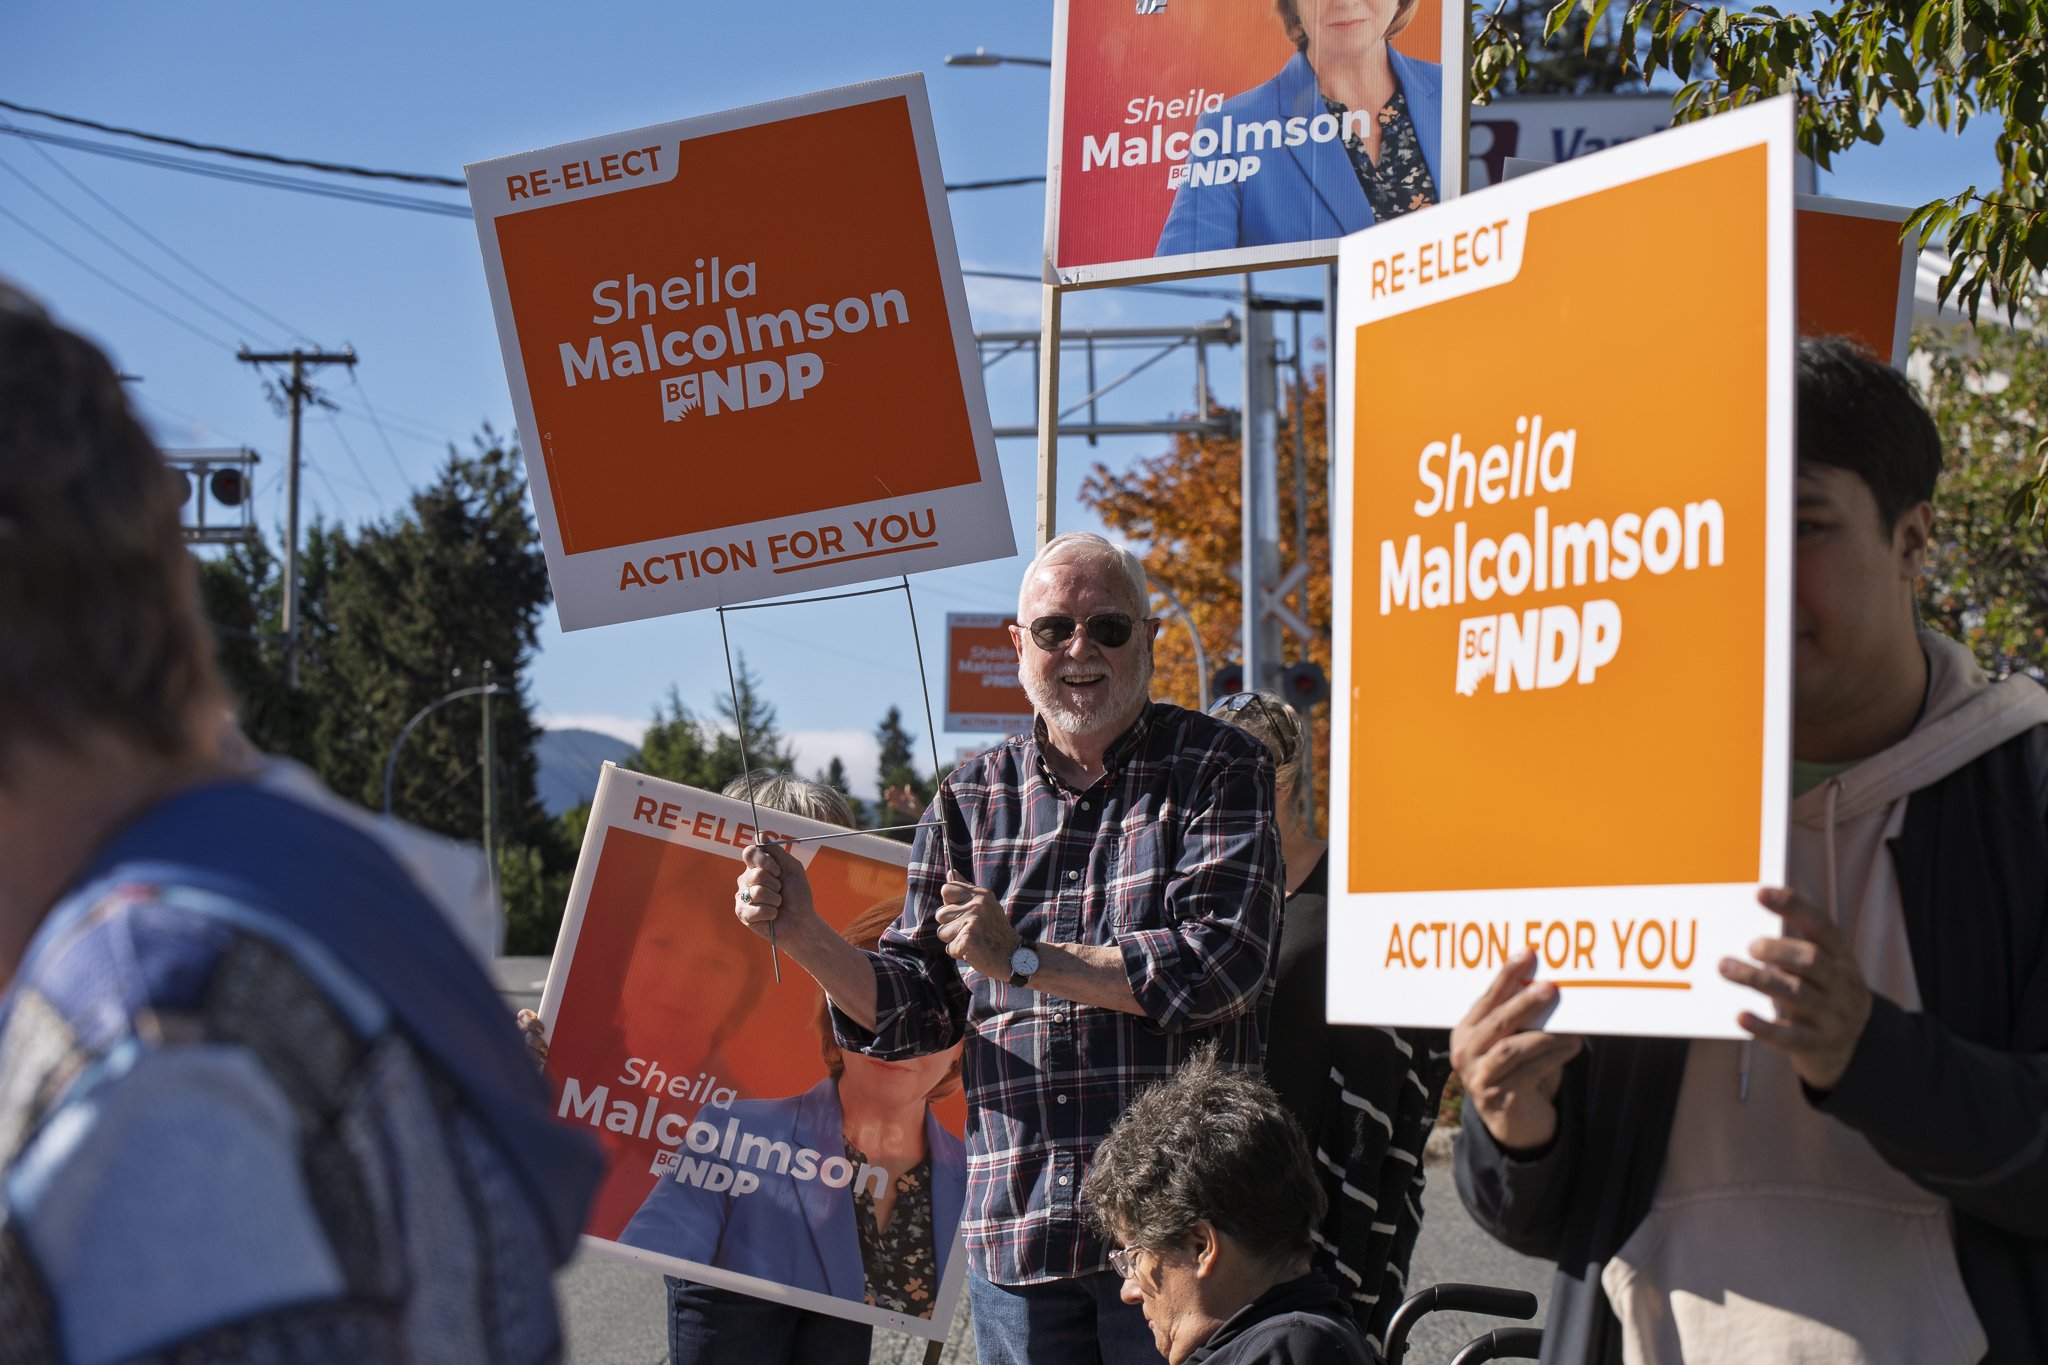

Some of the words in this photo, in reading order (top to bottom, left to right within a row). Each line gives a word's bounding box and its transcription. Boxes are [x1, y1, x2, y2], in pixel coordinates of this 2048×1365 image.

[1123, 88, 1224, 124] Sheila
[506, 146, 662, 201] RE-ELECT
[1082, 109, 1370, 172] Malcolmson
[1190, 156, 1261, 188] NDP
[592, 257, 757, 325] Sheila
[1371, 219, 1510, 300] RE-ELECT
[558, 288, 910, 387] Malcolmson
[700, 352, 825, 417] NDP
[1413, 414, 1577, 518] Sheila
[619, 540, 758, 590] ACTION
[767, 525, 844, 564] FOR
[853, 508, 937, 546] YOU
[1379, 498, 1725, 615] Malcolmson
[1494, 599, 1622, 693] NDP
[1384, 921, 1510, 970] ACTION
[1612, 918, 1698, 971] YOU
[618, 1057, 738, 1111] Sheila
[557, 1077, 889, 1199] Malcolmson
[675, 1155, 760, 1198] NDP
